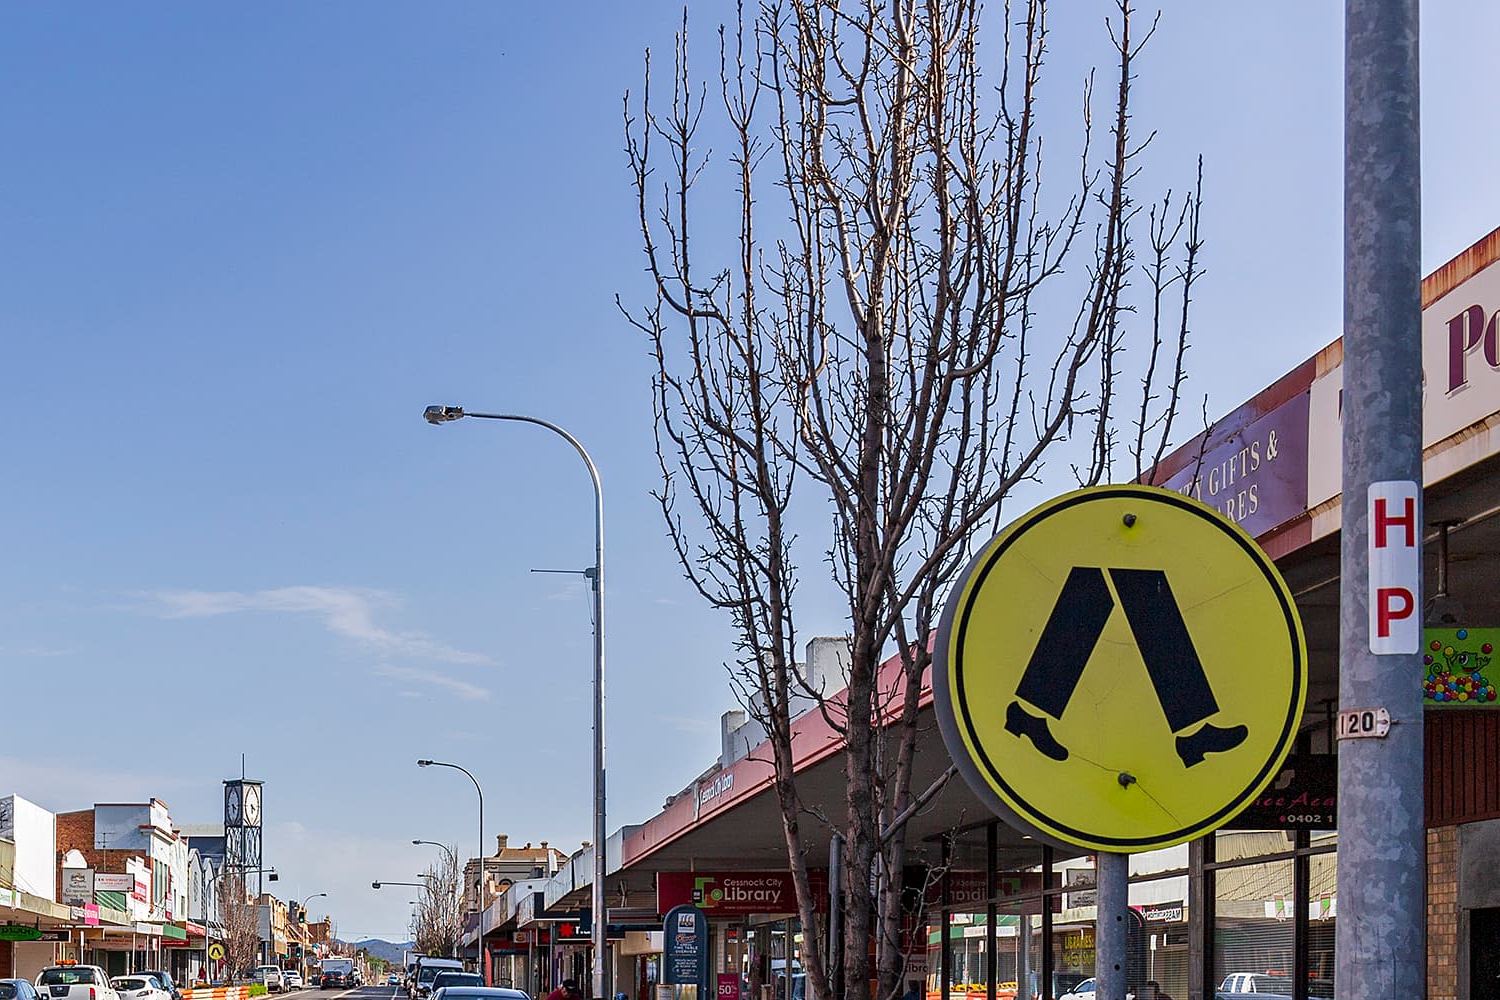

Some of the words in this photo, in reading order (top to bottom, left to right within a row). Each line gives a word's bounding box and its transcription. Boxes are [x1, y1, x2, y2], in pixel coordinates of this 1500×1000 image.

[1209, 441, 1260, 496] GIFTS
[1267, 430, 1278, 461] &
[723, 878, 765, 887] Cessnock
[765, 878, 783, 888] City
[724, 887, 781, 903] Library
